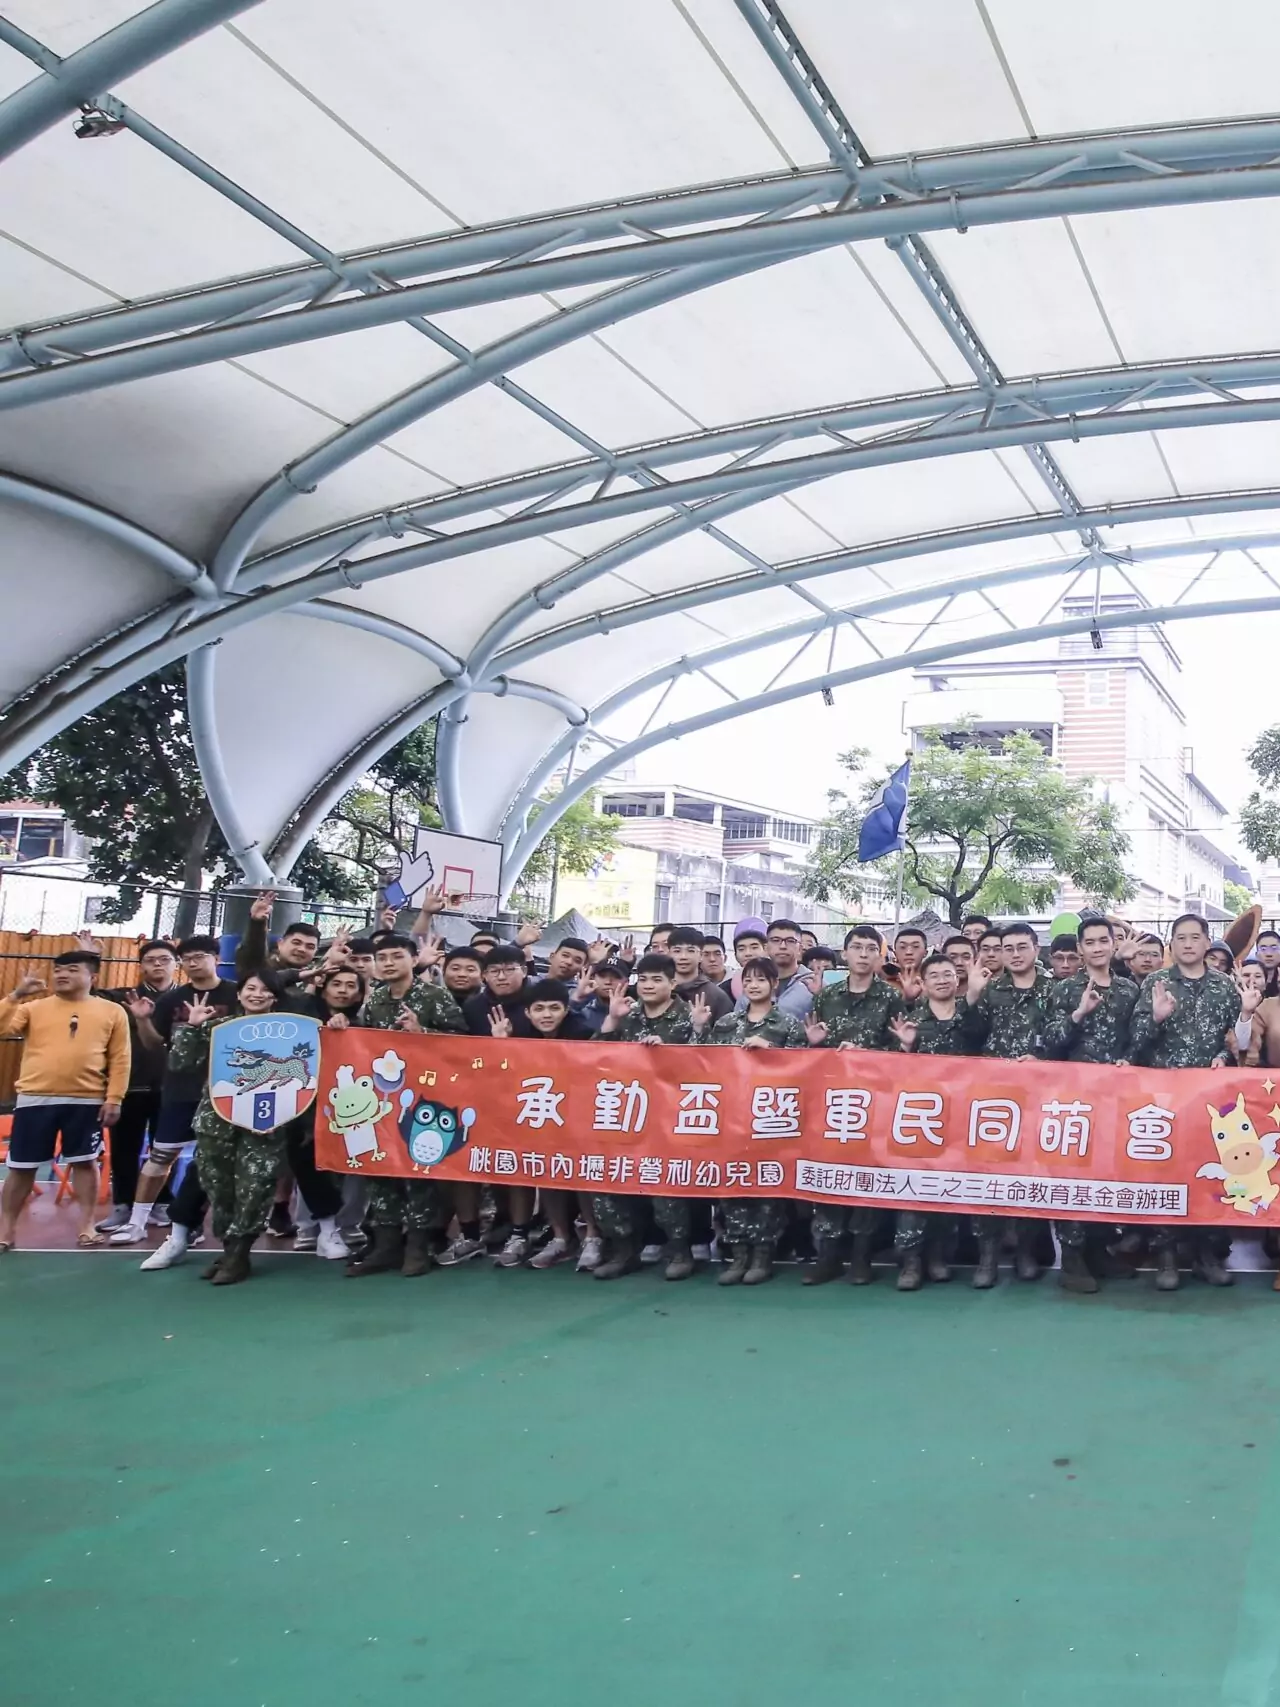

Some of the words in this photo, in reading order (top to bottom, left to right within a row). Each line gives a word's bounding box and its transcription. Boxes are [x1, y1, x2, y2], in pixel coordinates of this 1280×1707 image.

[258, 1100, 271, 1119] 3
[516, 1076, 1176, 1160] 承勤盃暨軍民同萌會
[469, 1146, 785, 1188] 桃園市內壢非營利幼兒園
[801, 1166, 1181, 1211] 委託財團法人三之三生命教育基金會辦理
